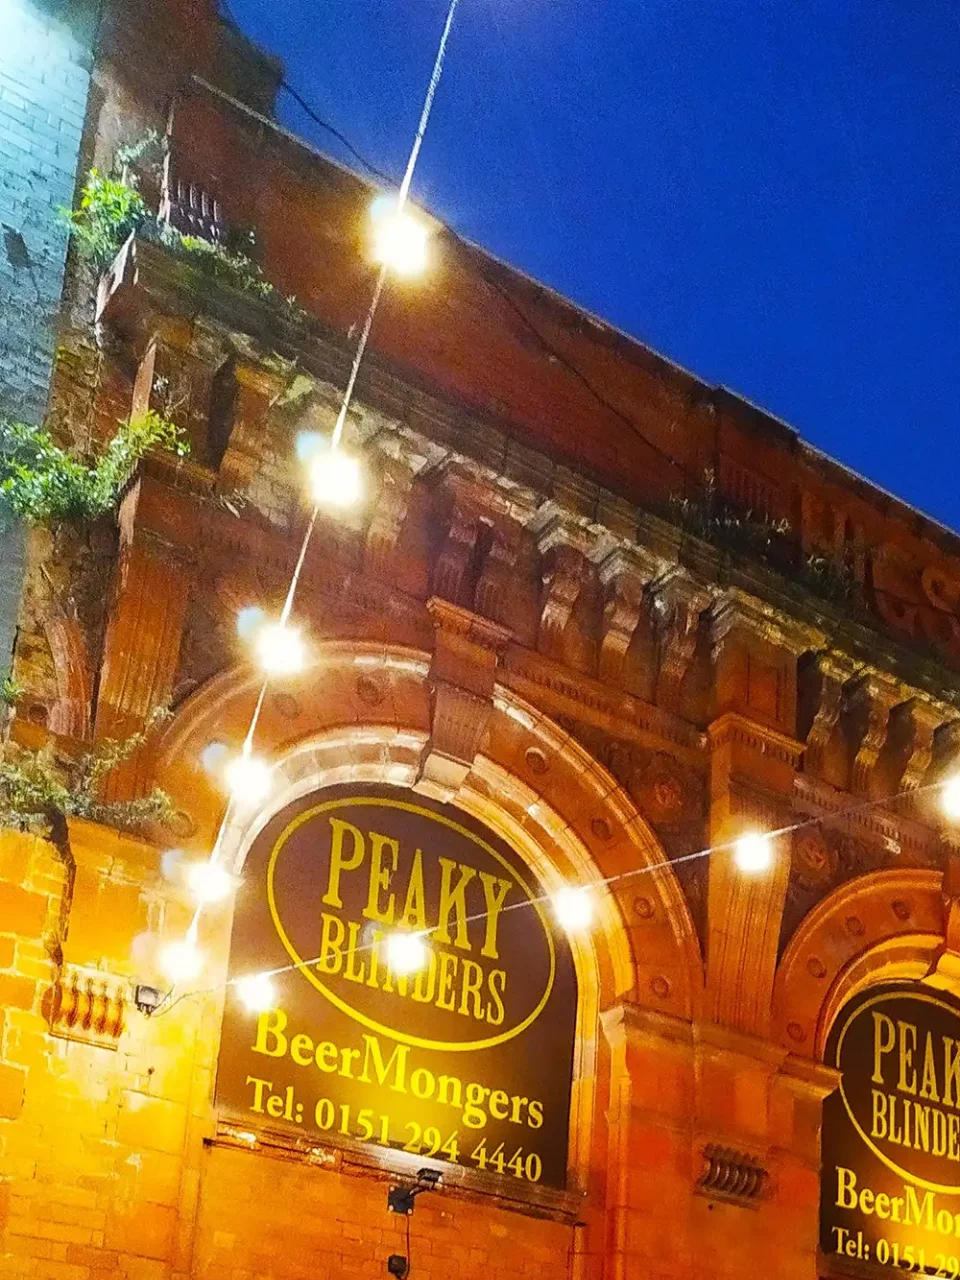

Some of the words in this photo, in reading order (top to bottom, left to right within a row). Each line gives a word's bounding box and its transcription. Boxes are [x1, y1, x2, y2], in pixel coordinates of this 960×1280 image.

[323, 818, 512, 960] PEAKY
[251, 1007, 544, 1129] BeerMongers
[245, 1075, 304, 1123] Tel:
[315, 1098, 390, 1147] 0151
[402, 1122, 461, 1164] 294
[470, 1137, 543, 1183] 4440
[831, 1226, 870, 1260] Tel:
[876, 1238, 927, 1274] 0151
